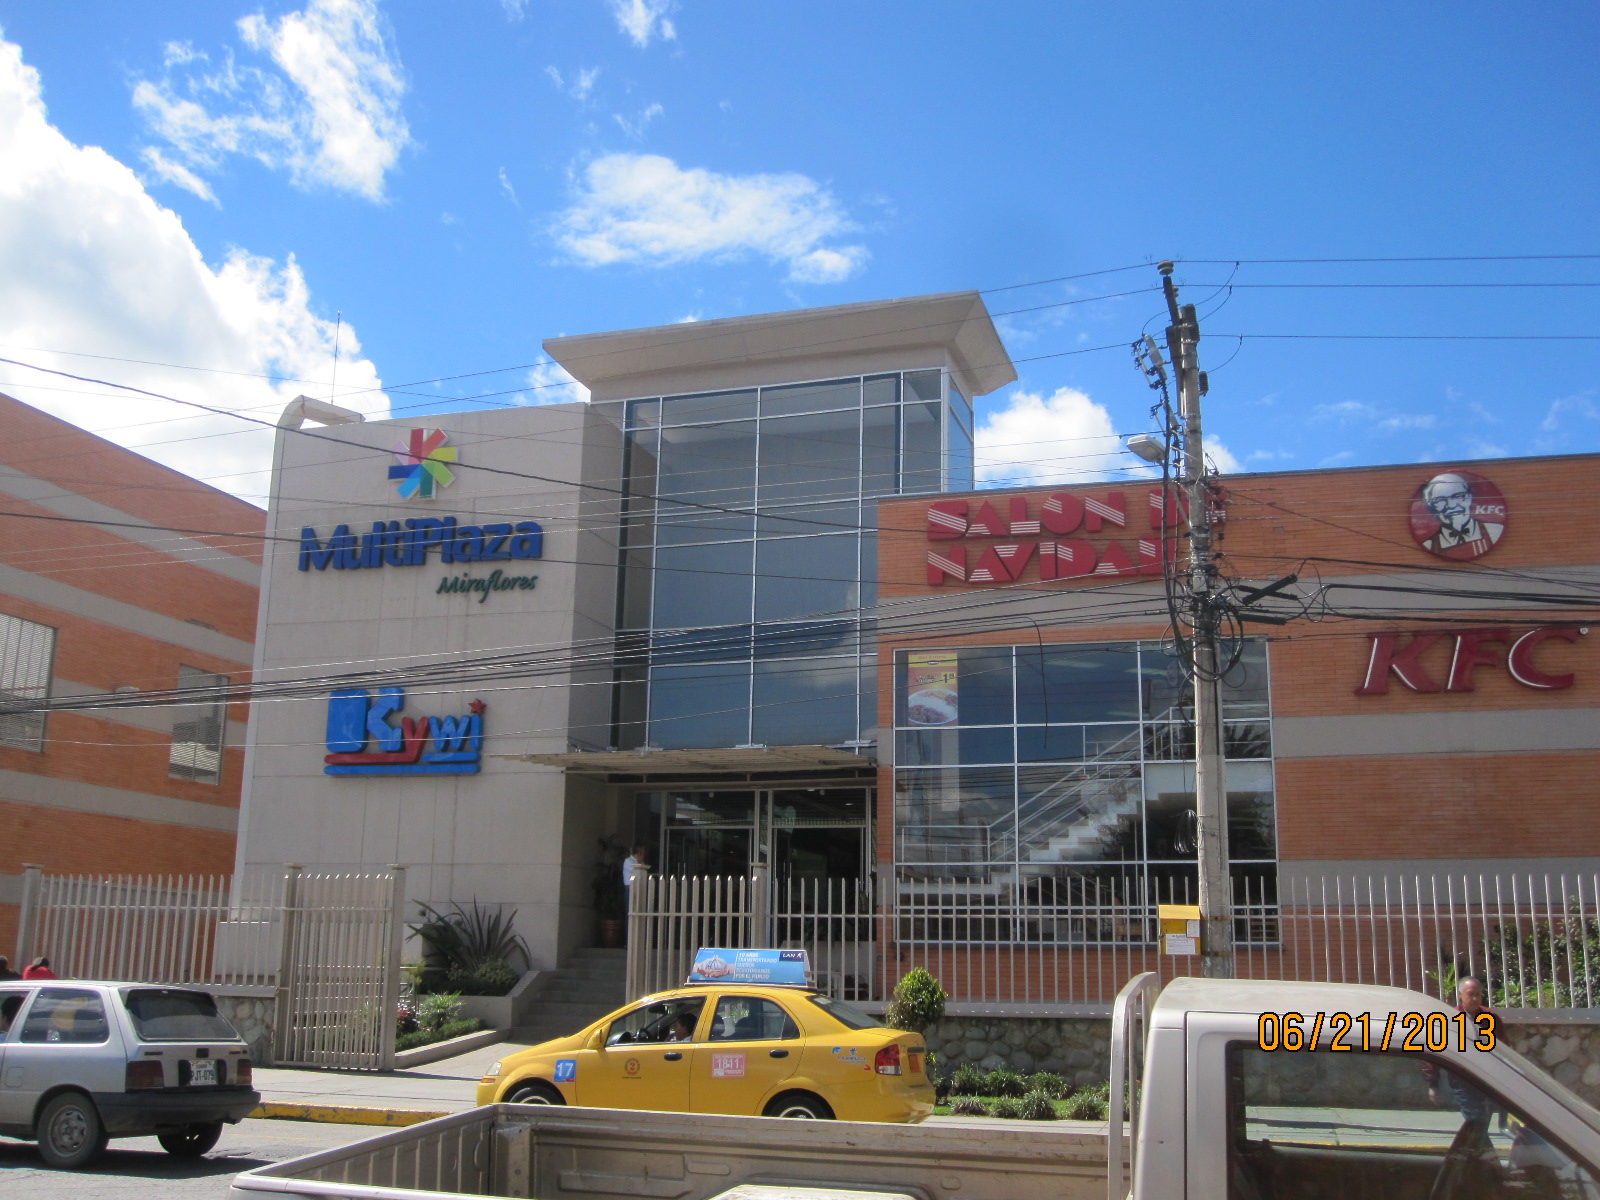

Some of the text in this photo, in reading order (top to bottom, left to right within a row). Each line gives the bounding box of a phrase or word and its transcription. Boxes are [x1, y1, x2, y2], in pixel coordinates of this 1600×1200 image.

[927, 492, 1126, 541] SALON
[1475, 505, 1504, 516] KFC
[298, 516, 543, 572] MultiPlaza
[436, 569, 538, 603] Miraflores
[1354, 625, 1582, 696] KFC
[557, 1062, 574, 1077] 17
